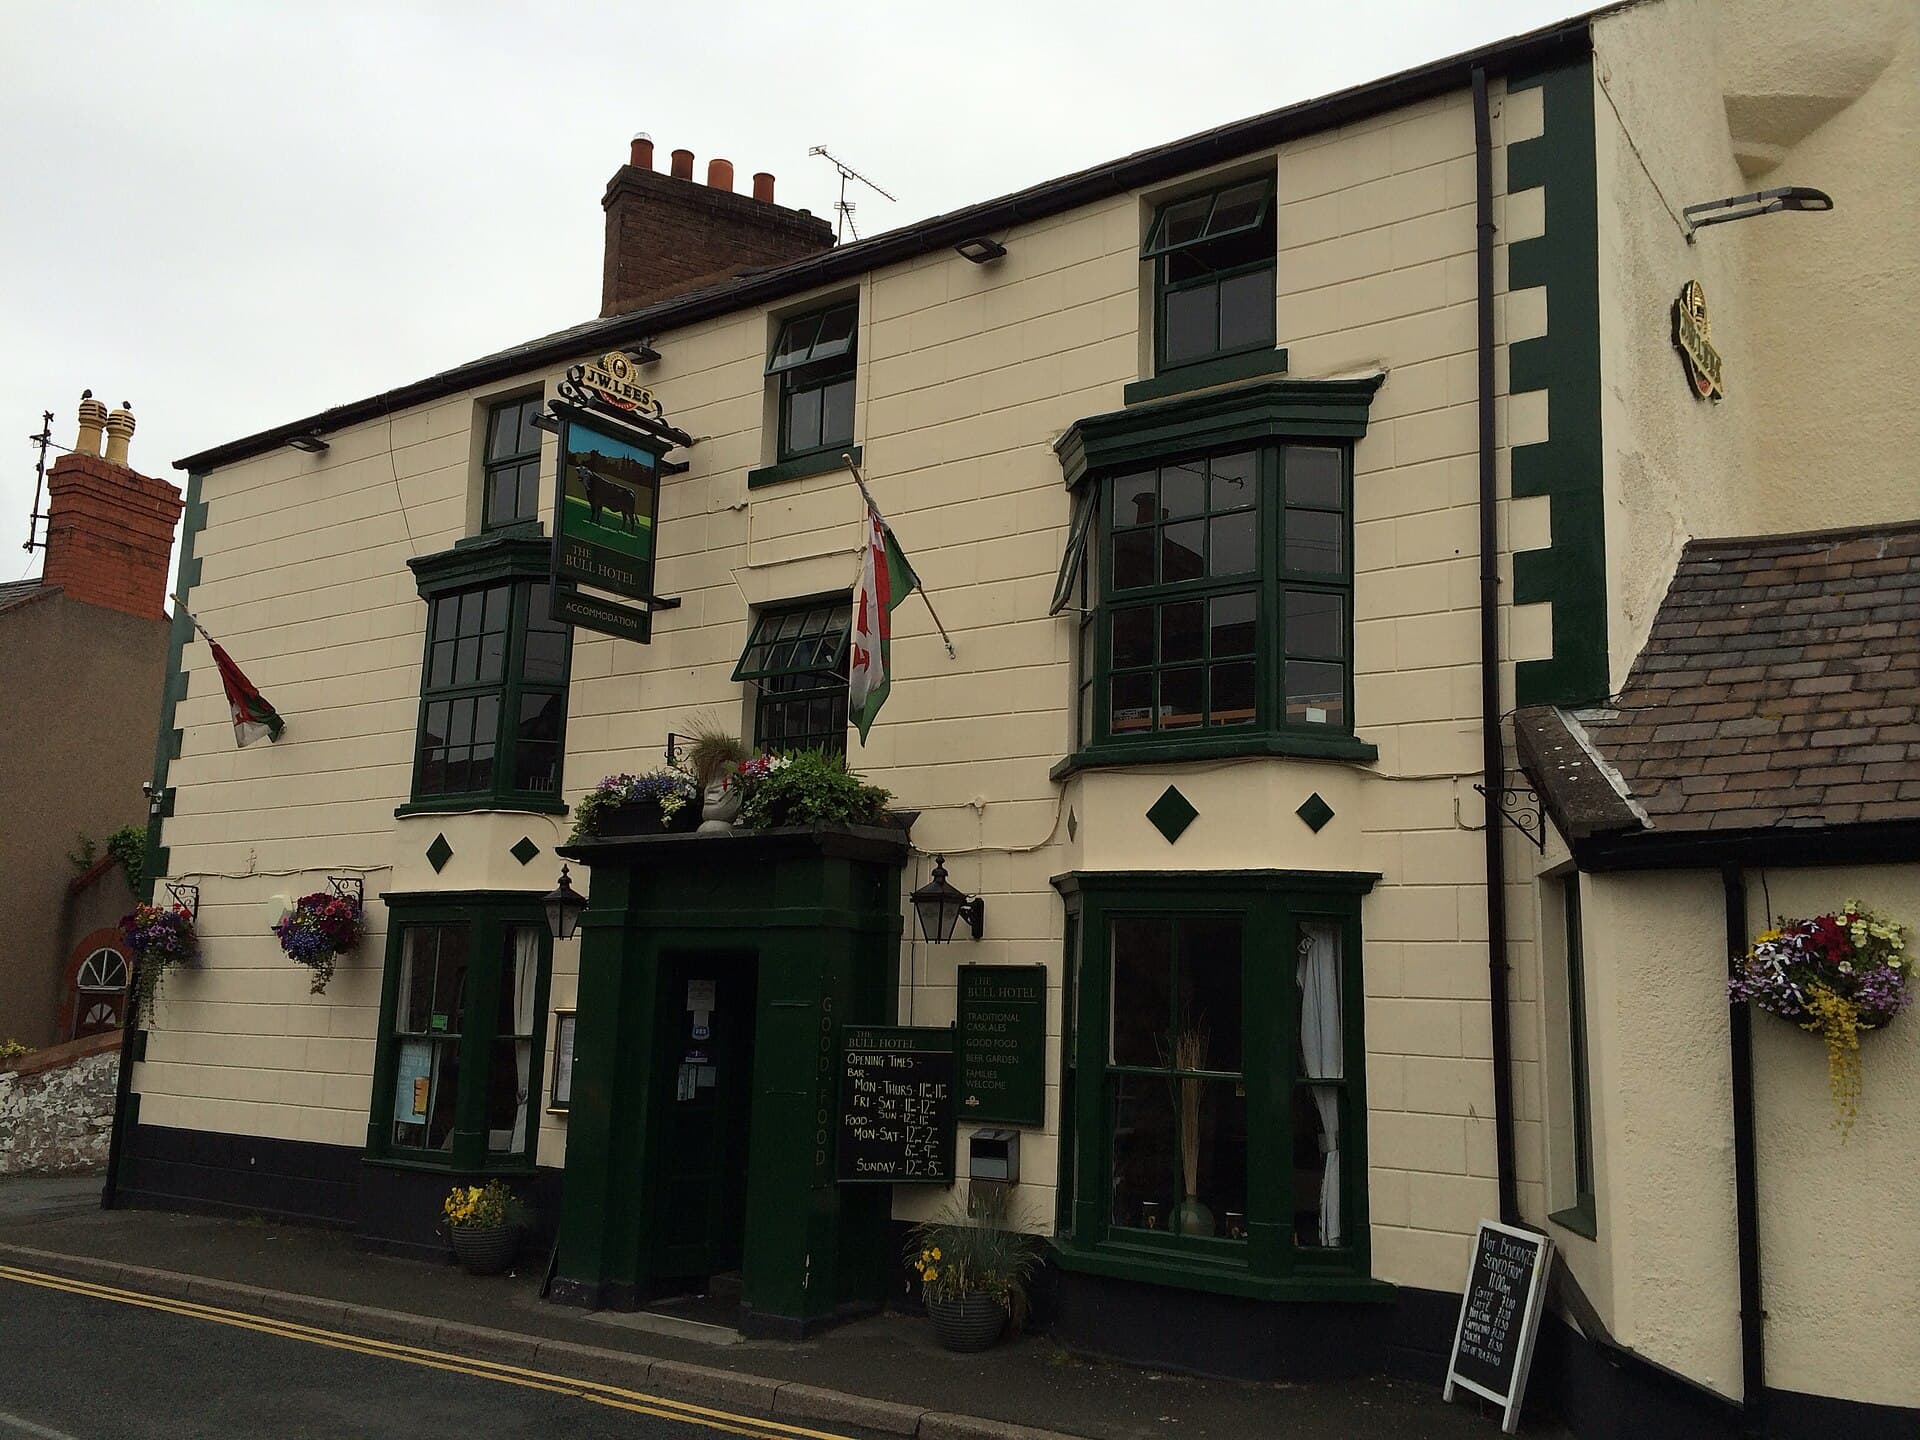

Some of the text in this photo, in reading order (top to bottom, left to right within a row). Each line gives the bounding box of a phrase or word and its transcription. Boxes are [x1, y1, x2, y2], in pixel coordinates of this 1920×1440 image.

[586, 369, 651, 405] J.W.LEES
[572, 544, 592, 558] THE
[566, 554, 636, 585] BULL HOTEL
[565, 602, 638, 628] ACCOMMODATION
[967, 986, 1037, 998] BULL HOTEL
[967, 1012, 1021, 1022] TRADITIONAL
[820, 997, 832, 1072] GOOD
[848, 1038, 915, 1049] BULL HOTEL
[966, 1039, 1018, 1048] GOOD FOOD
[847, 1052, 884, 1068] OPENING
[888, 1054, 914, 1069] TIMES
[985, 1054, 1019, 1064] GARDEN
[966, 1080, 1007, 1089] WELCOME
[856, 1158, 896, 1173] SUNDAY
[1482, 1231, 1497, 1252] HOT
